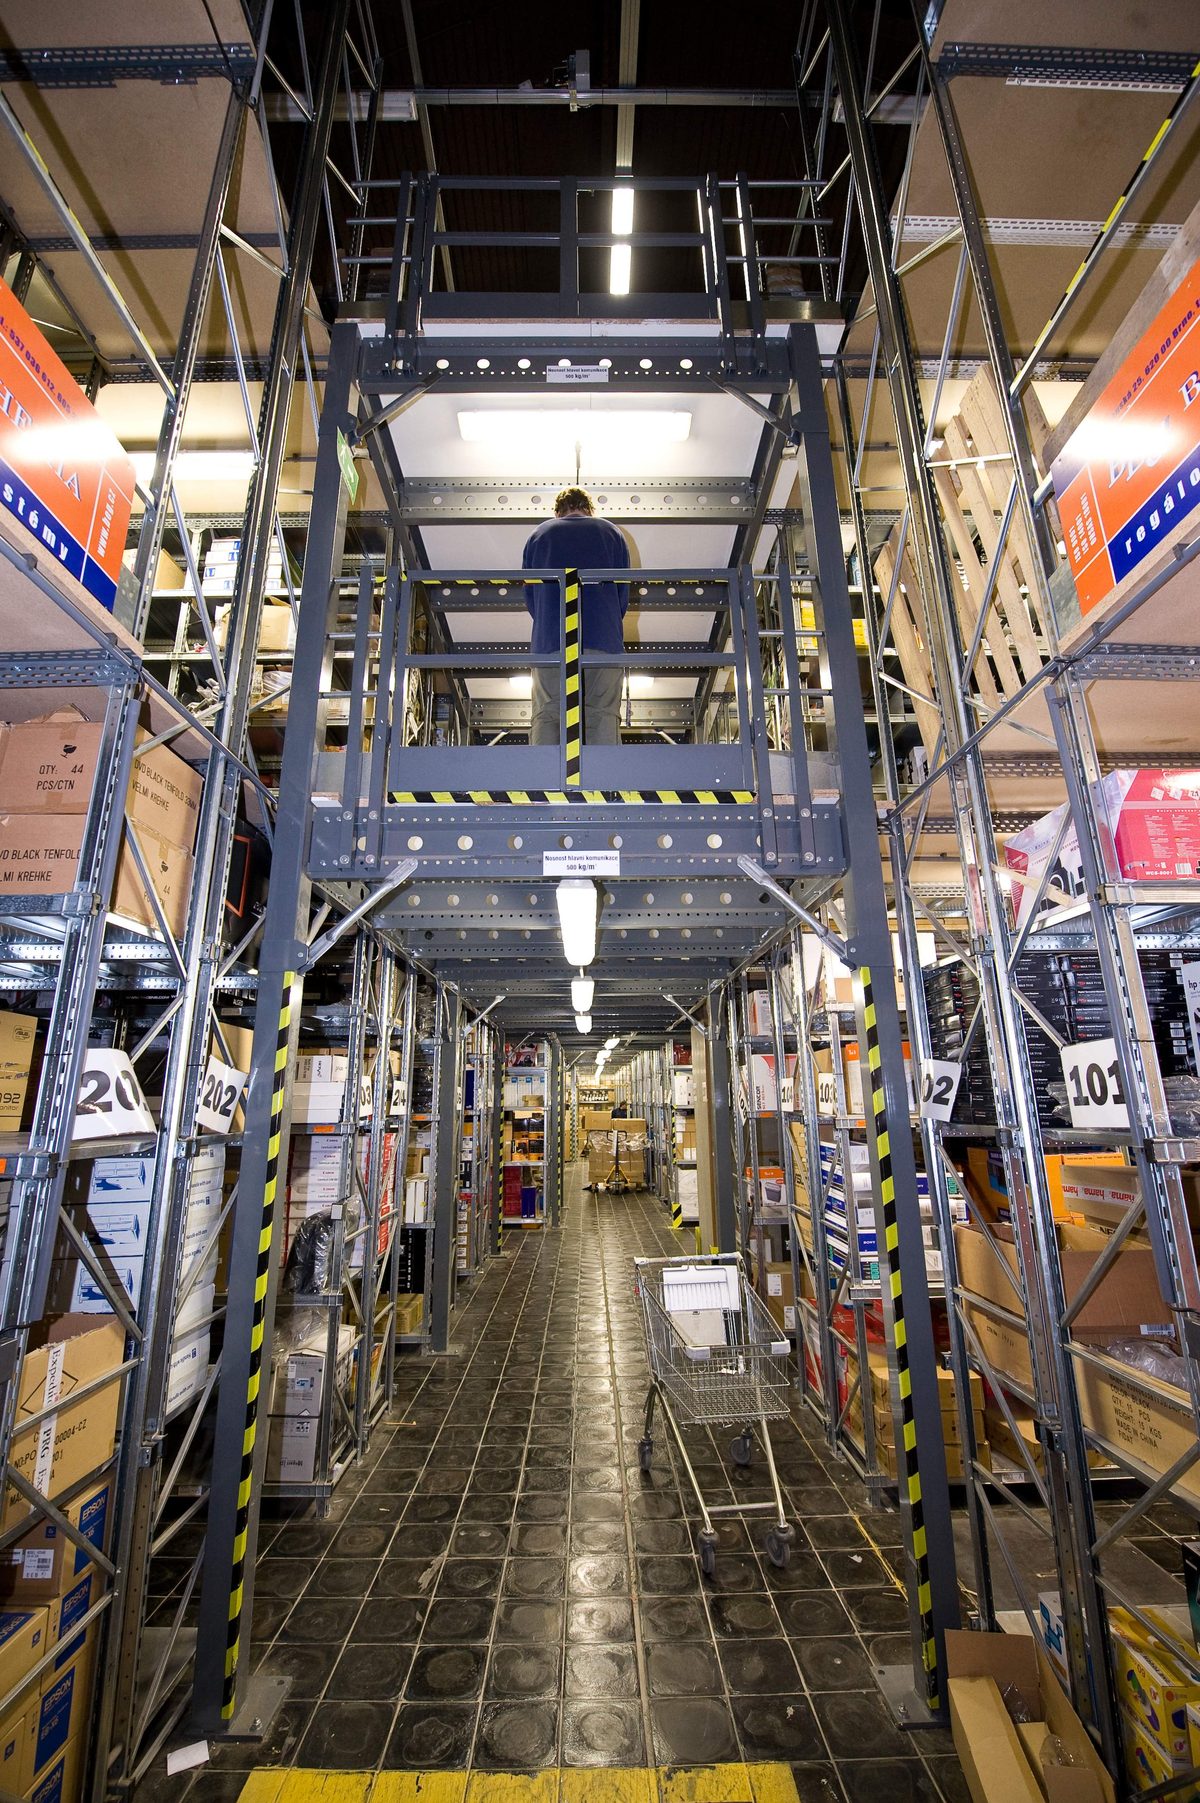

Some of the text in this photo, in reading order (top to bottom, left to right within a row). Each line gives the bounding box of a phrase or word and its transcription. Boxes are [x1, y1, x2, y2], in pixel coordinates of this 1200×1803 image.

[71, 764, 84, 774] 44
[146, 767, 164, 786] BLACK
[36, 780, 75, 790] PCS/CTN
[11, 849, 40, 860] BLACK
[17, 870, 52, 882] KREHKE
[1188, 980, 1197, 991] hp
[1069, 1059, 1126, 1106] 101
[76, 1069, 150, 1116] 20
[202, 1073, 237, 1118] 202
[1083, 1184, 1105, 1200] hama
[1138, 1409, 1151, 1423] PCS
[40, 1426, 53, 1459] PRG
[1115, 1418, 1158, 1449] MADE IN CHINA
[1149, 1426, 1162, 1440] KGS
[82, 1494, 106, 1521] EPSON
[63, 1583, 89, 1613] EPSON
[44, 1676, 72, 1713] EPSON
